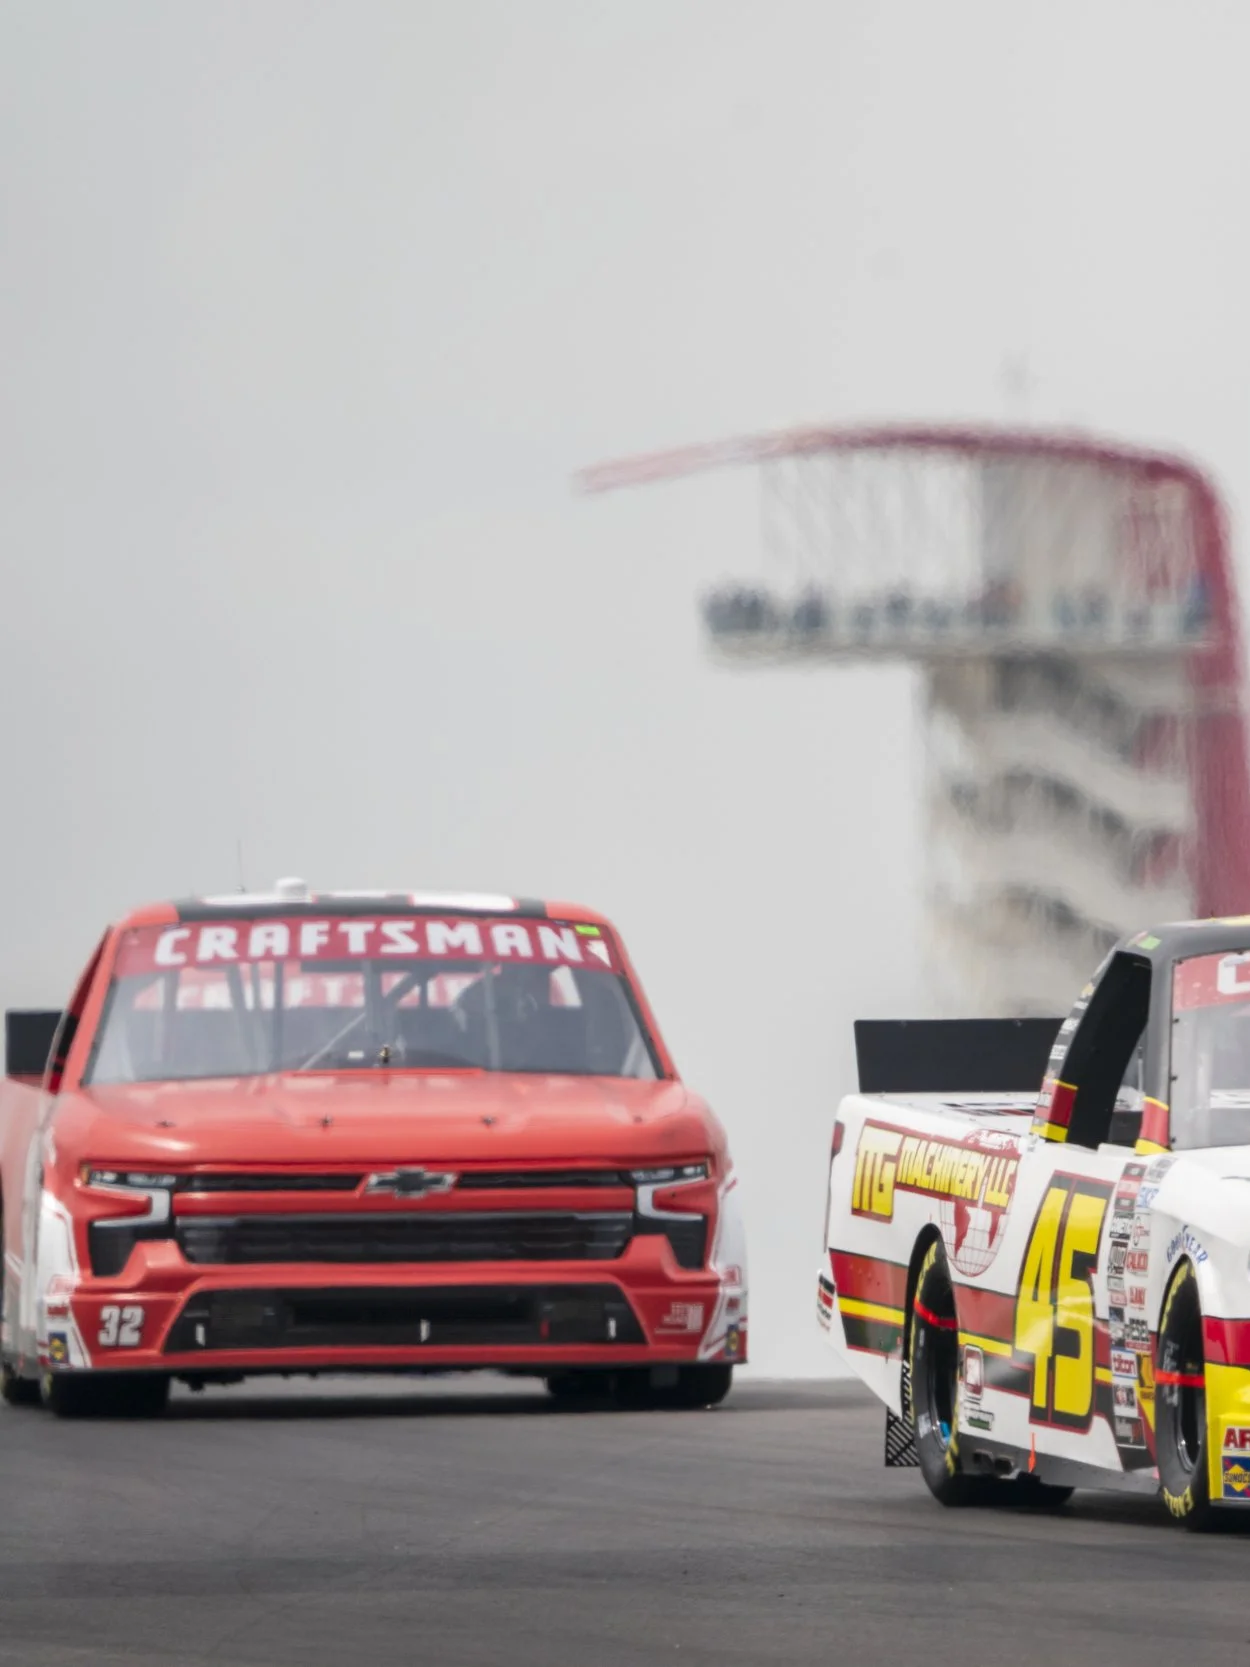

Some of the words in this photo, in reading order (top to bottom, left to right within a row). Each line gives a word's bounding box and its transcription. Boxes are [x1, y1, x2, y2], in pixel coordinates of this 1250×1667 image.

[154, 920, 585, 965] CRAFTSMAN
[896, 1136, 986, 1201] MACHINERY
[98, 1304, 144, 1347] 32
[1014, 1187, 1107, 1417] 45
